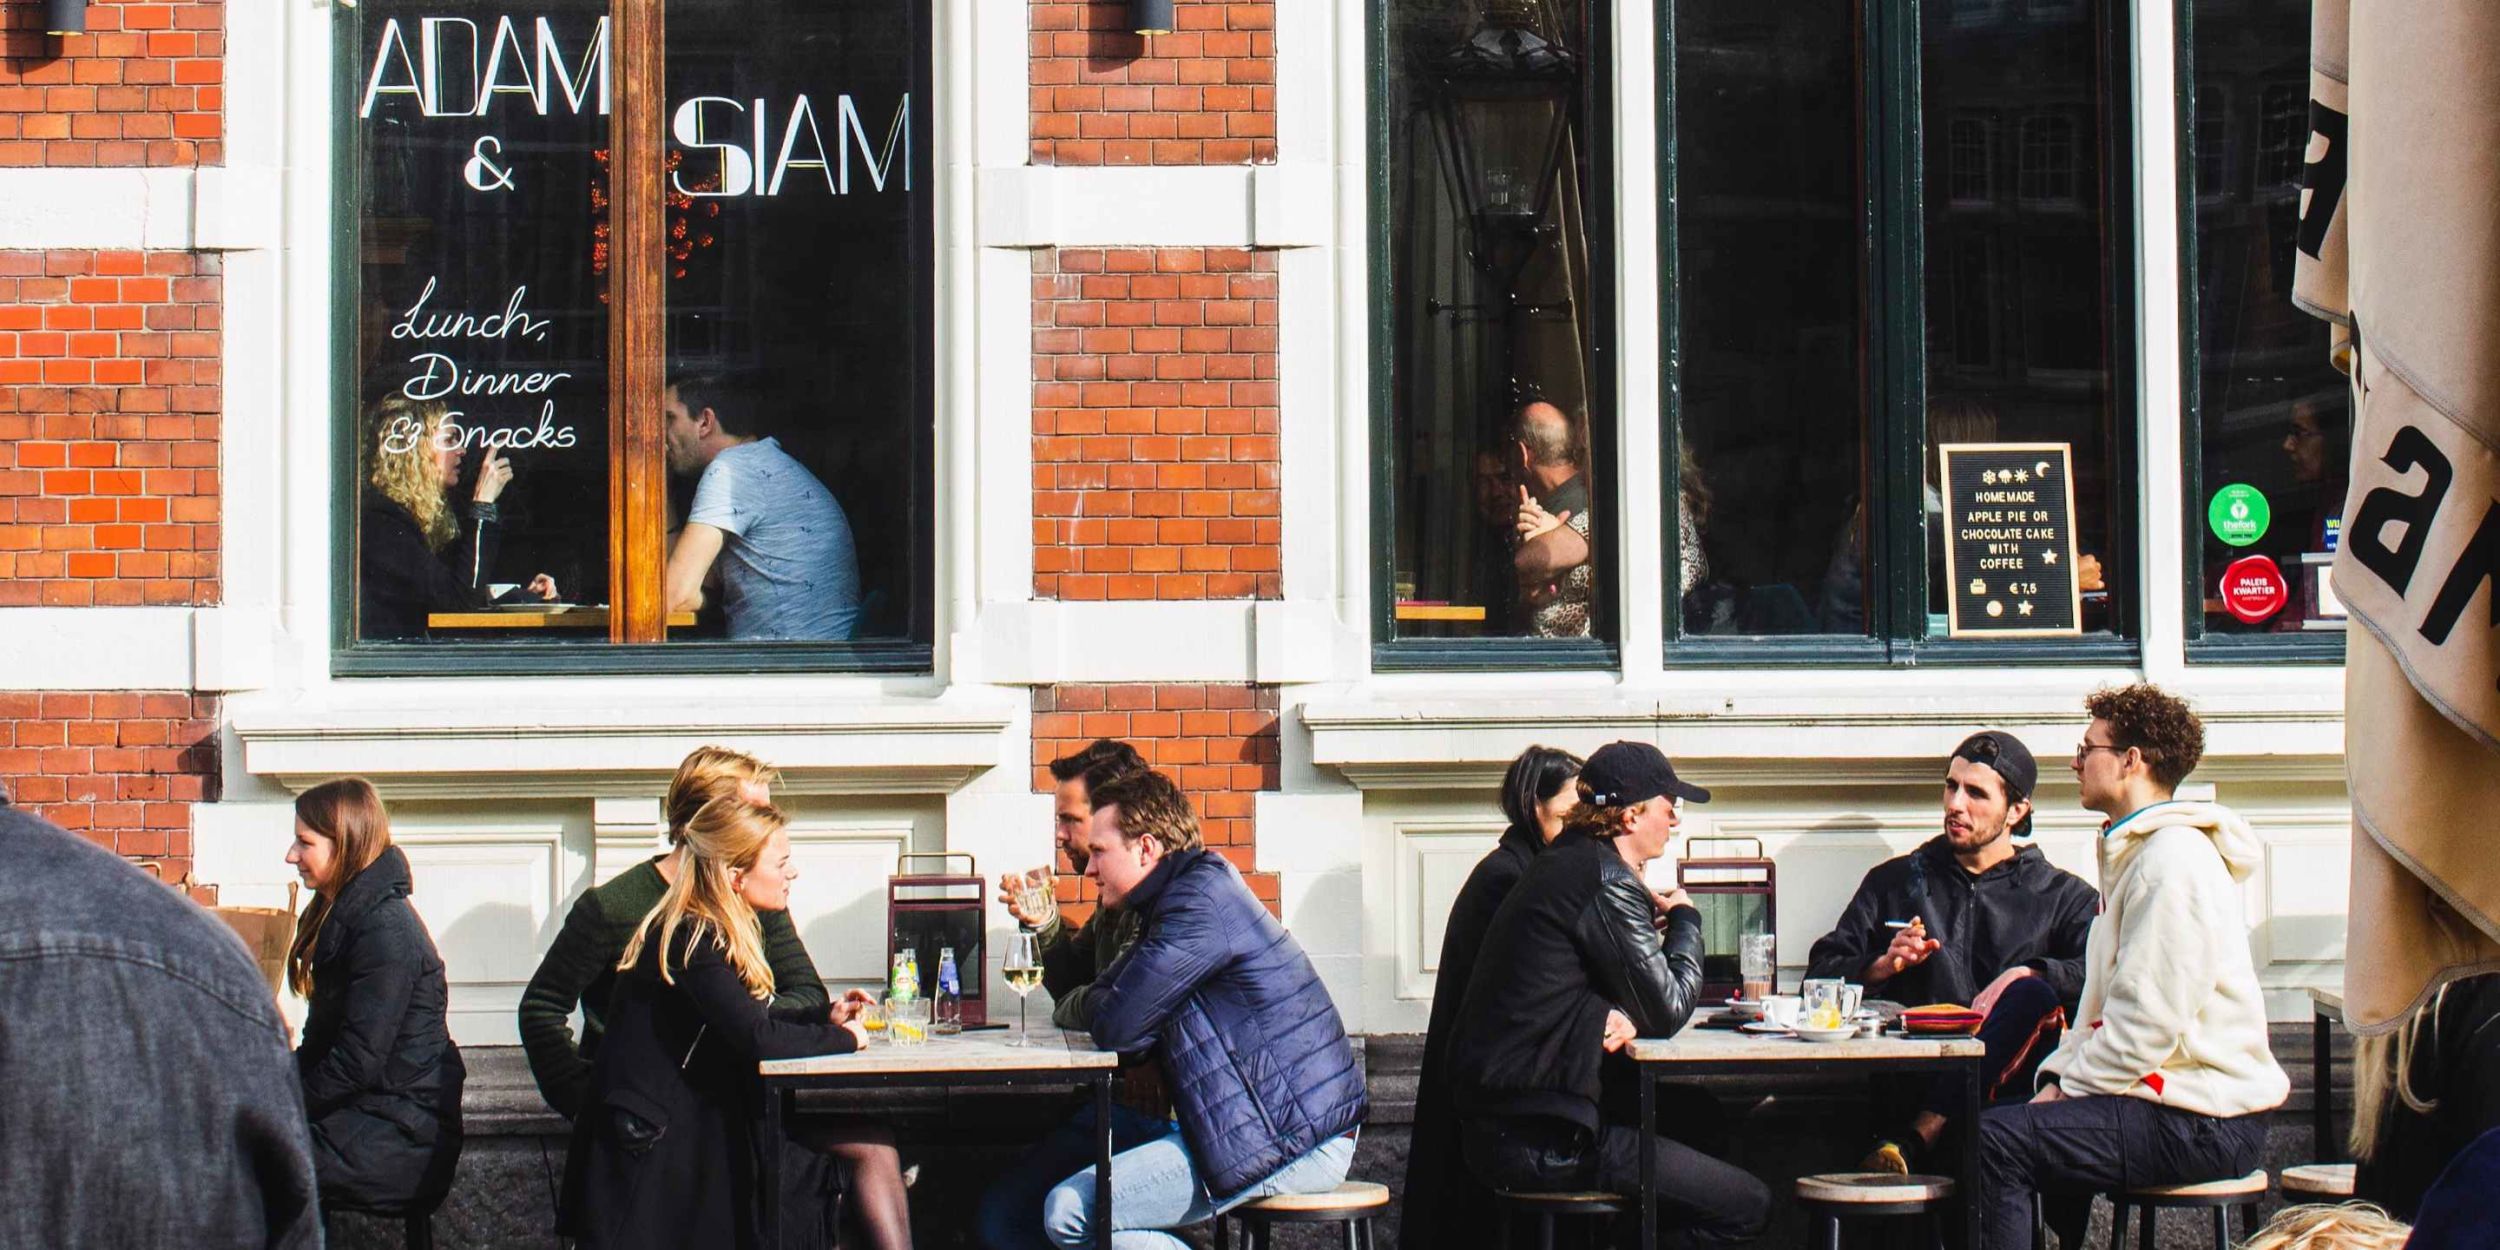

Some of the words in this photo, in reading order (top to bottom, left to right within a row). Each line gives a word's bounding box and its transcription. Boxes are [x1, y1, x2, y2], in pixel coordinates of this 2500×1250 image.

[360, 15, 610, 118] ADAM
[673, 92, 910, 196] SIAM
[464, 136, 515, 191] &
[391, 275, 550, 341] Lunch,
[403, 353, 572, 400] Dinner
[383, 416, 422, 454] &
[432, 399, 576, 451] Snacks
[1975, 491, 2036, 503] HOMEMADE
[1967, 511, 2003, 523] APPLE
[2007, 511, 2027, 522] PIE
[2033, 511, 2049, 522] OR
[1961, 528, 2023, 540] CHOCOLATE
[2025, 528, 2055, 539] CAKE
[1988, 543, 2019, 554] WITH
[1980, 558, 2024, 569] COFFEE
[2240, 578, 2268, 587] PALEIS
[2233, 586, 2275, 596] KWARTIER
